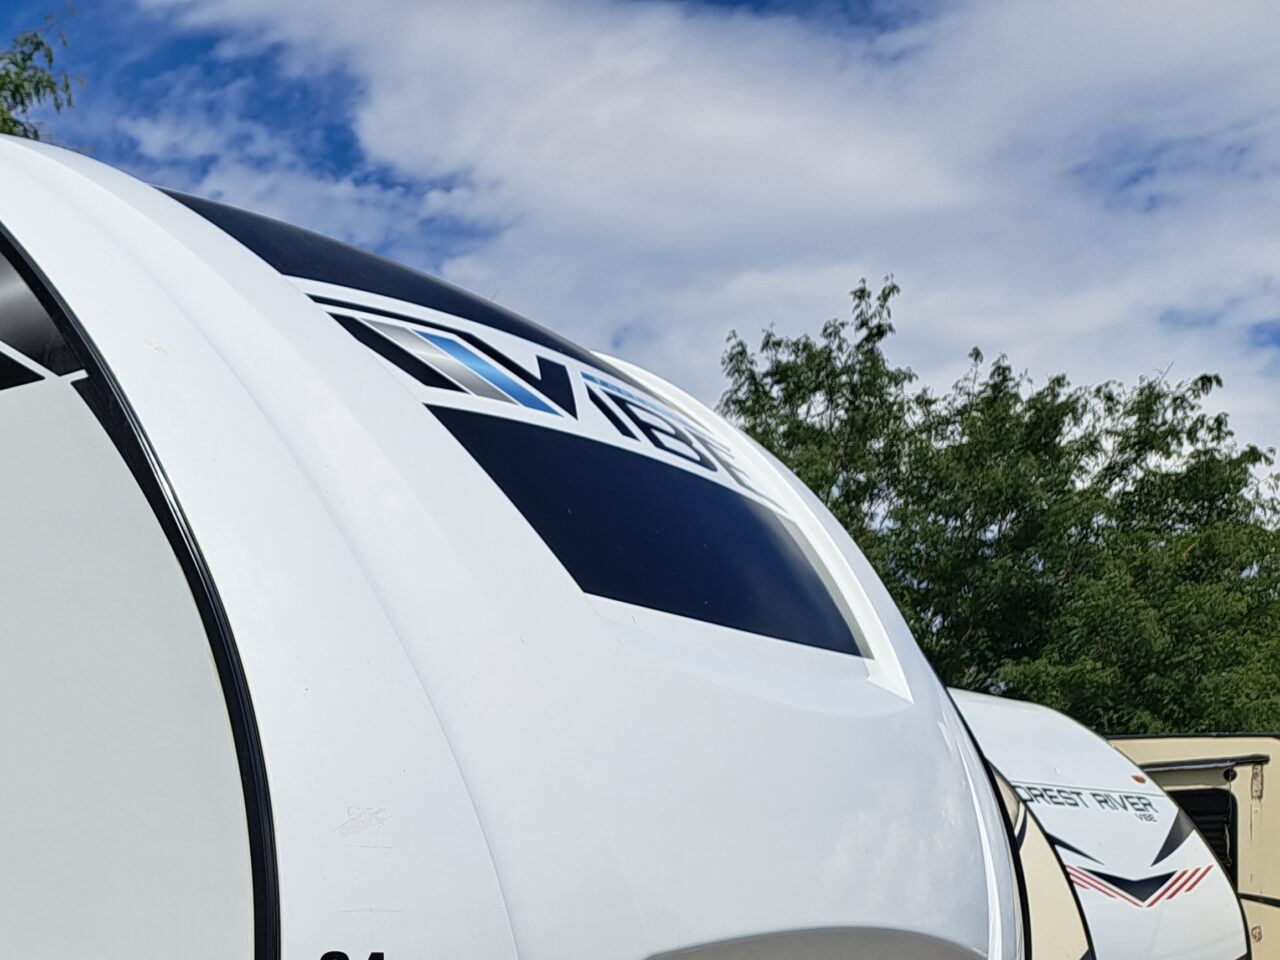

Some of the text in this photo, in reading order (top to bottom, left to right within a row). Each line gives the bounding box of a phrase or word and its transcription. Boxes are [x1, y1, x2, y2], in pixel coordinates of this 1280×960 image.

[304, 292, 789, 514] VIBE
[1012, 785, 1159, 813] OREST RIVER
